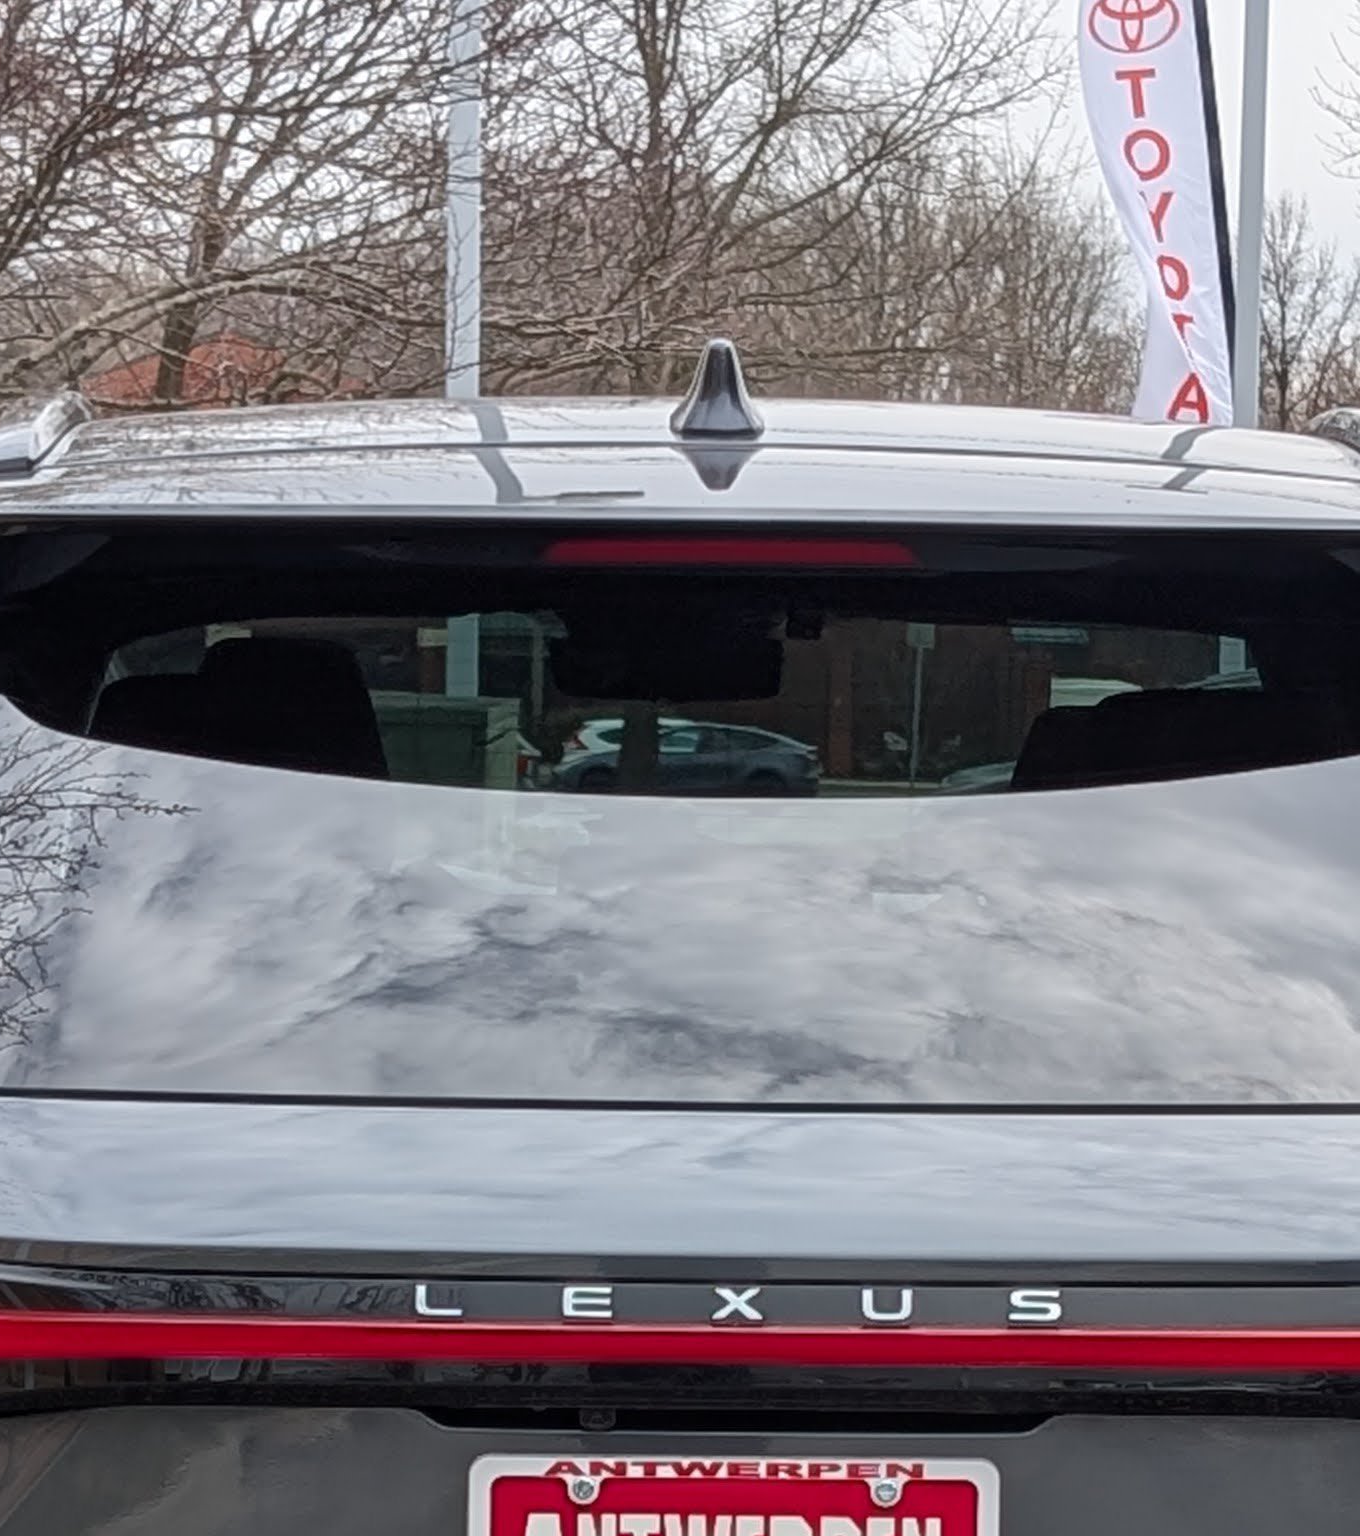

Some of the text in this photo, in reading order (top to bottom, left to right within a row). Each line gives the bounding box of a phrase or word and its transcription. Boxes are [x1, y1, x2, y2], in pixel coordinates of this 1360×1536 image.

[1115, 68, 1209, 424] TOYOTA
[414, 1283, 1063, 1322] LEXUS
[544, 1460, 925, 1479] ANTWERPEN
